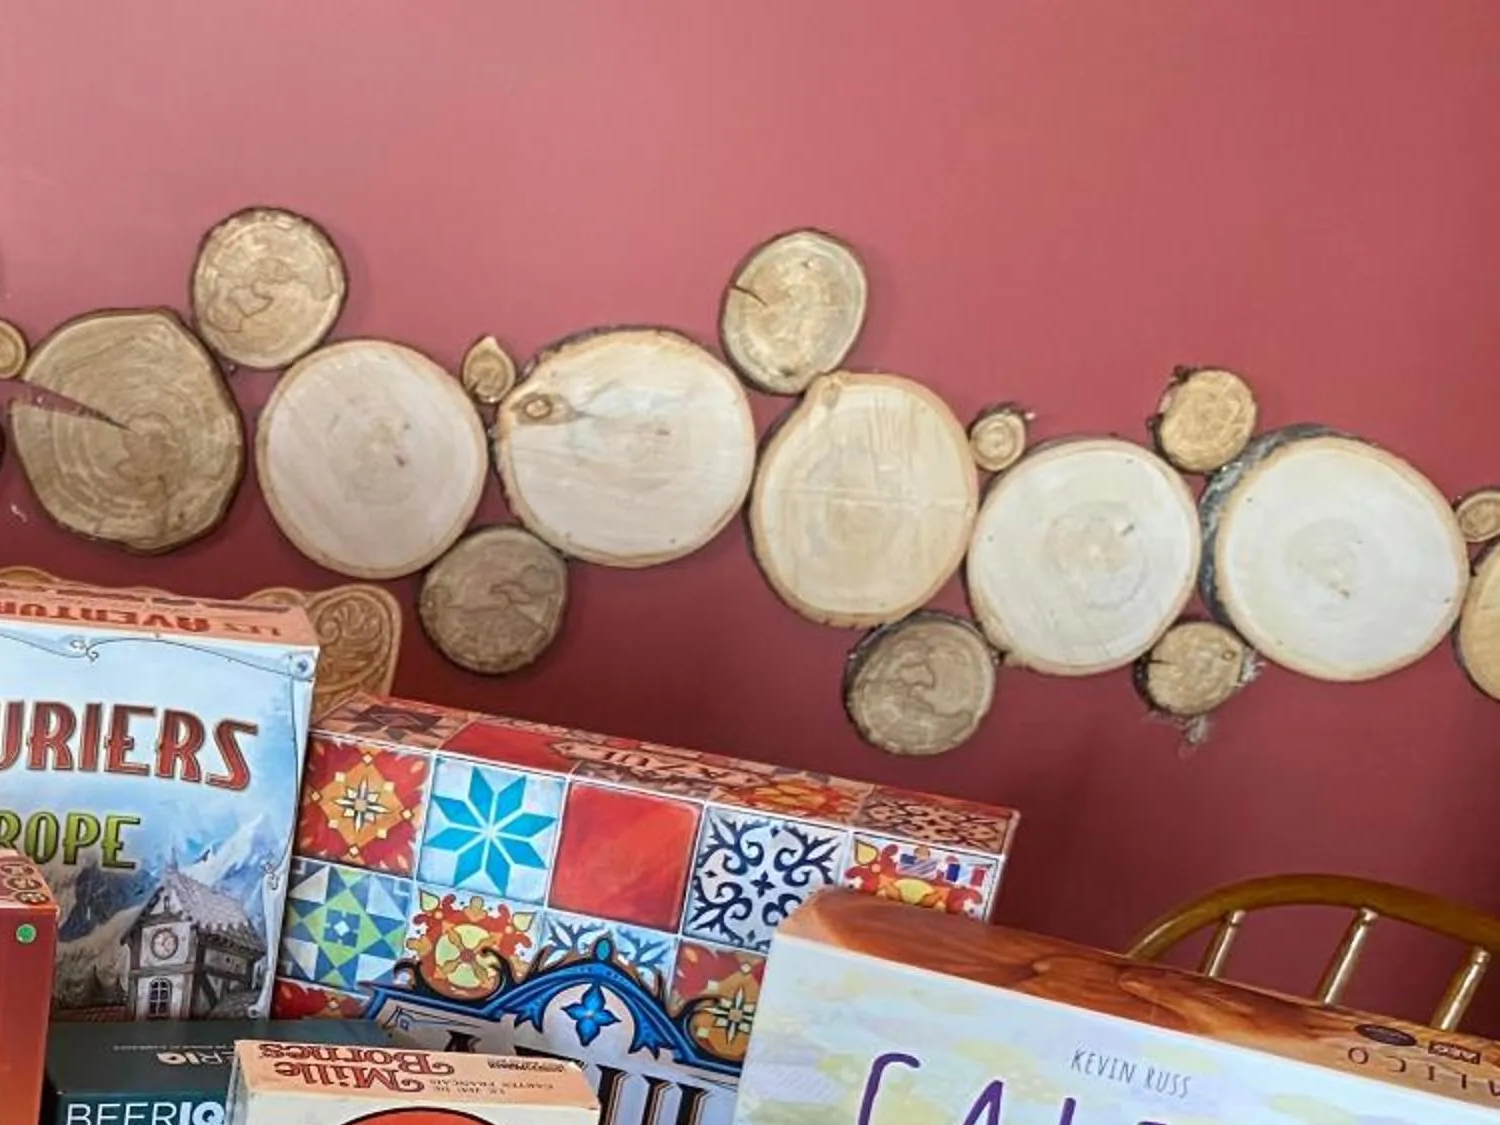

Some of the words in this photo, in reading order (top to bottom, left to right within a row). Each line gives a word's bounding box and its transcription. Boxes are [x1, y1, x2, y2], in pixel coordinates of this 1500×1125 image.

[259, 1042, 455, 1076] Bornes
[1070, 1046, 1137, 1087] KEVIN
[1141, 1061, 1192, 1101] RUSS
[274, 1060, 425, 1094] Mille
